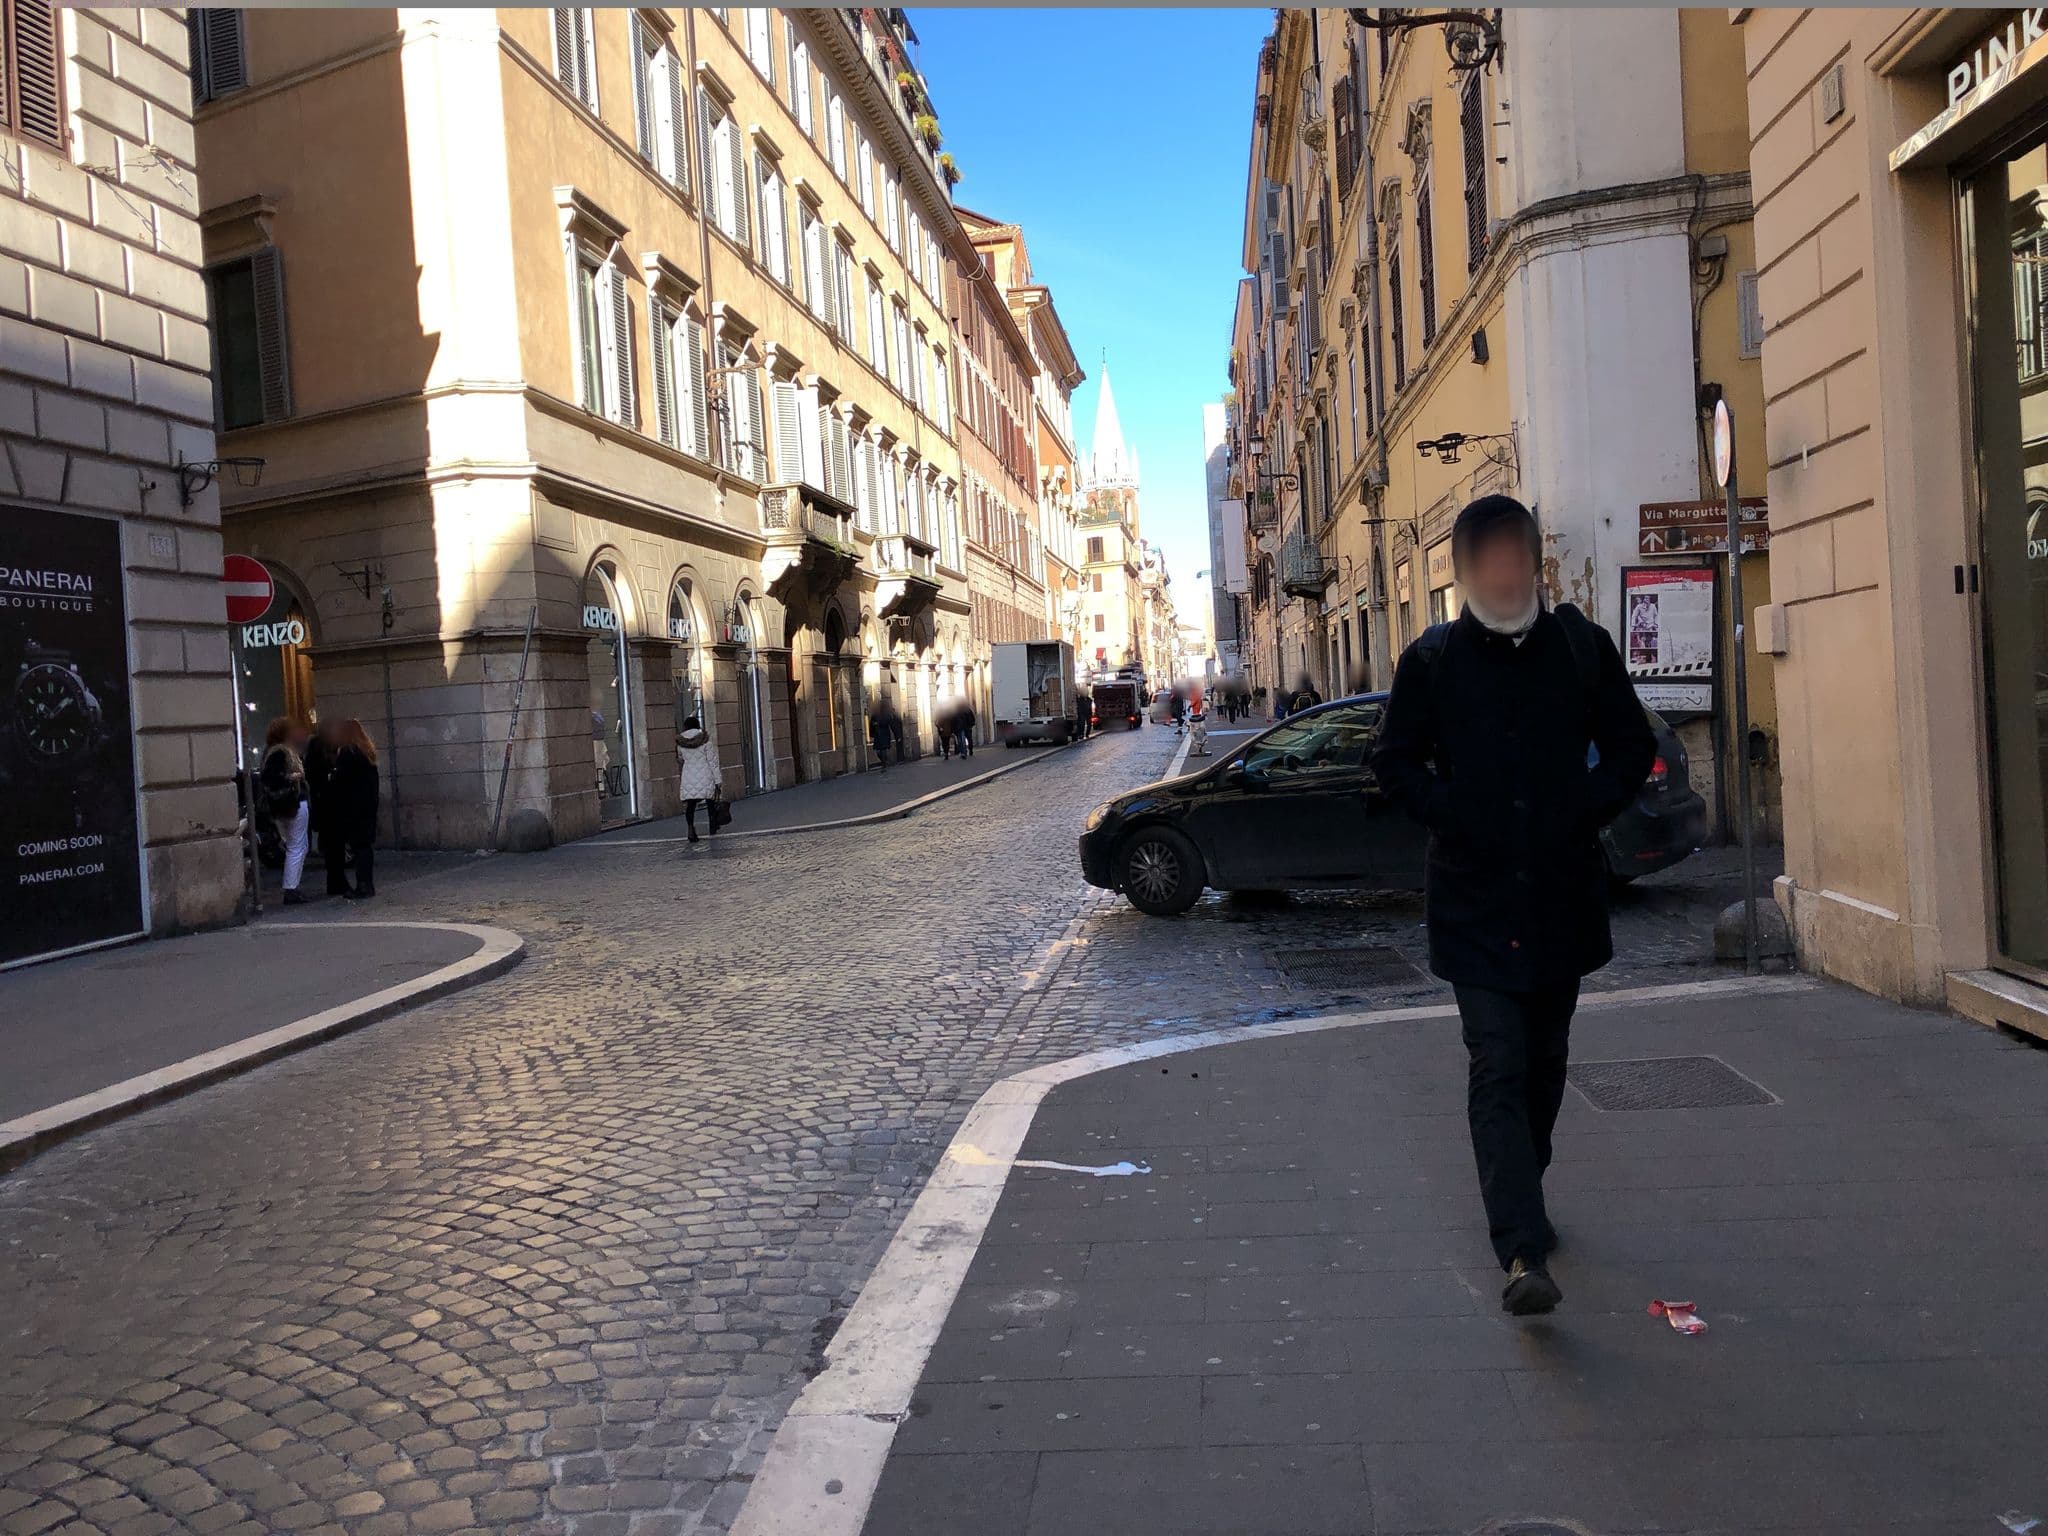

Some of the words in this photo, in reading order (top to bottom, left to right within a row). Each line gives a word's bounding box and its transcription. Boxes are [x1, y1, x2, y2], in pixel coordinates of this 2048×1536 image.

[1645, 510, 1663, 520] Via
[1668, 506, 1727, 519] Margutta
[0, 567, 92, 591] PANERAI
[0, 596, 93, 611] BOUTIQUE
[583, 605, 618, 630] KENZO
[242, 620, 304, 648] KENZO
[18, 839, 67, 856] COMING
[70, 835, 102, 849] SOON
[20, 862, 104, 885] PANERAI.COM
